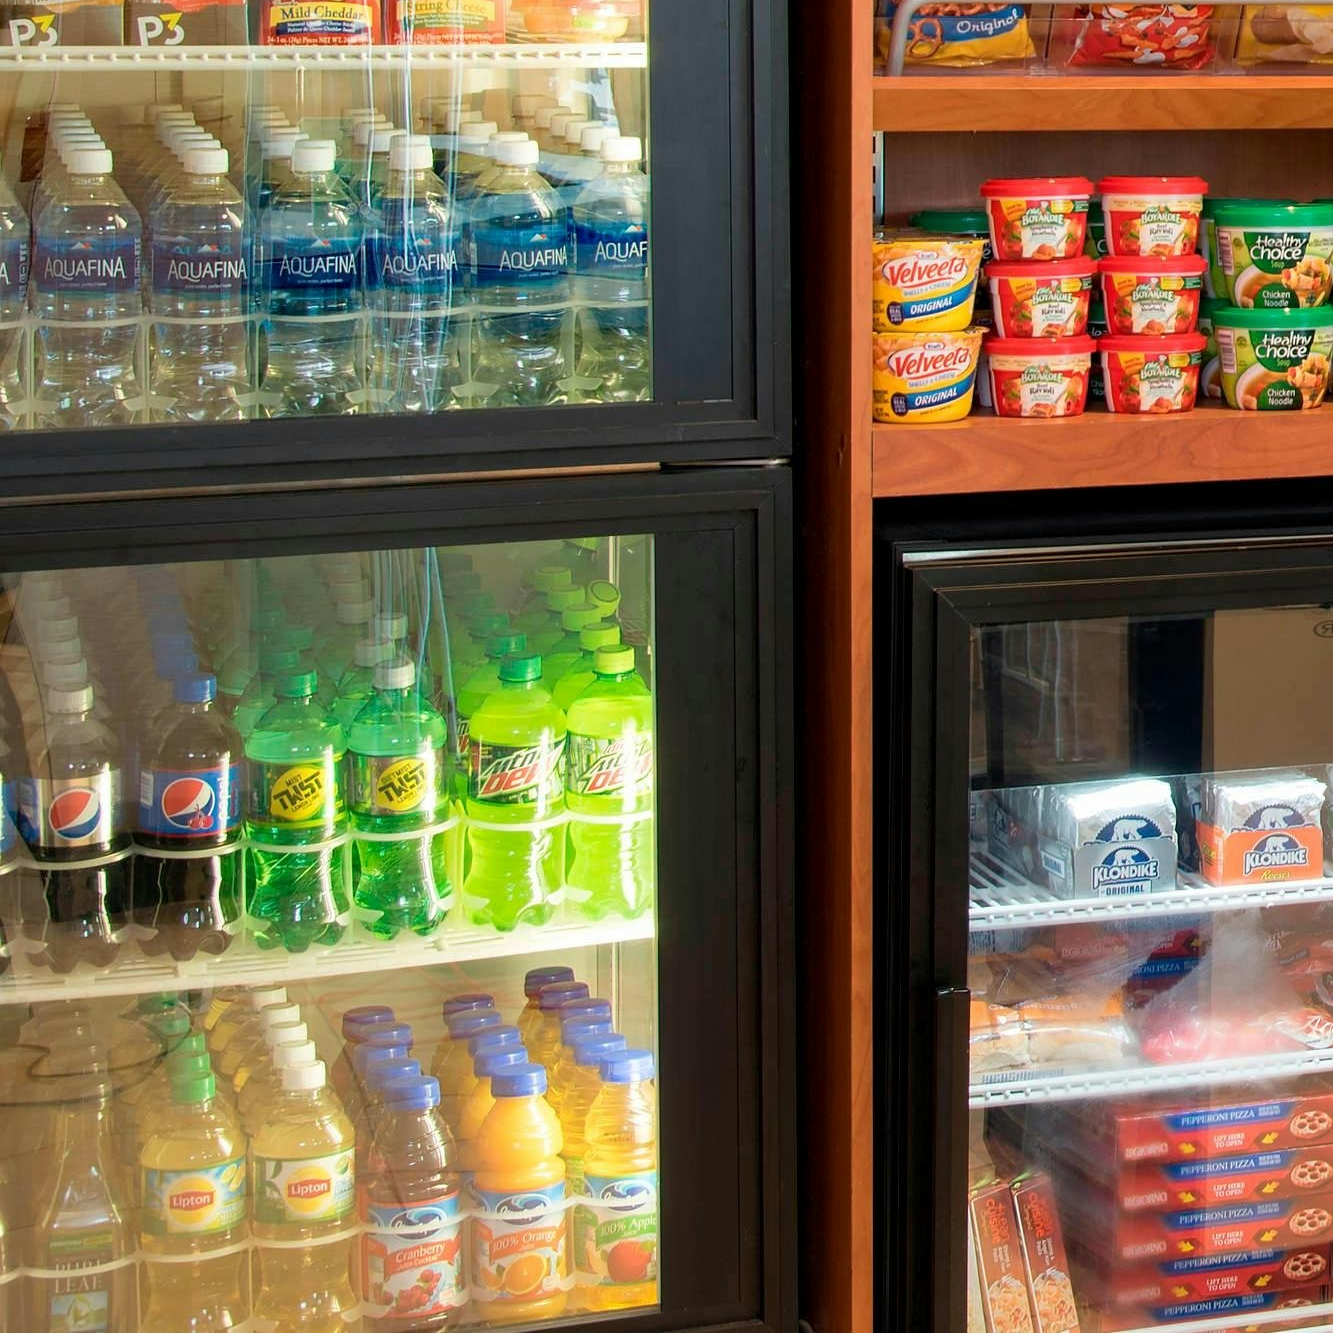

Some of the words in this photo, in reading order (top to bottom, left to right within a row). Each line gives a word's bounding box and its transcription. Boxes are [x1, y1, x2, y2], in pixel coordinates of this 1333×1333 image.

[281, 6, 311, 21] Mild
[313, 5, 366, 20] Cheddar
[956, 9, 1018, 34] Original
[1250, 243, 1302, 260] Choice
[1257, 234, 1307, 253] Healthy
[45, 256, 127, 281] AQUAFINA
[280, 253, 357, 279] AQUAFINA
[382, 249, 458, 279] AQUAFINA
[499, 246, 567, 274] AQUAFINA
[168, 257, 248, 283] AQUAFINA
[888, 256, 966, 286] Velveeta
[1262, 290, 1291, 300] Chicken
[1264, 298, 1289, 307] Noodle
[910, 296, 953, 315] ORIGINAL
[1256, 342, 1308, 358] Choice
[1263, 332, 1312, 351] Healthy
[894, 348, 969, 379] Velveeta
[915, 387, 958, 406] ORIGINAL
[1267, 388, 1295, 398] Chicken
[1268, 396, 1293, 407] Noodle
[1244, 847, 1308, 874] KLONDIKE
[1091, 859, 1160, 888] KLONDIKE
[1105, 883, 1145, 896] ORIGINAL
[1181, 1112, 1229, 1126] PEPPERONI
[1230, 1109, 1255, 1120] PIZZA
[1180, 1161, 1229, 1175] PEPPERONI
[1231, 1159, 1255, 1169] PIZZA
[291, 1181, 328, 1197] Lipton
[172, 1192, 211, 1208] Lipton
[601, 1221, 625, 1236] 100%
[492, 1236, 518, 1252] 100%
[522, 1230, 556, 1243] Orange
[395, 1243, 445, 1264] Cranberry
